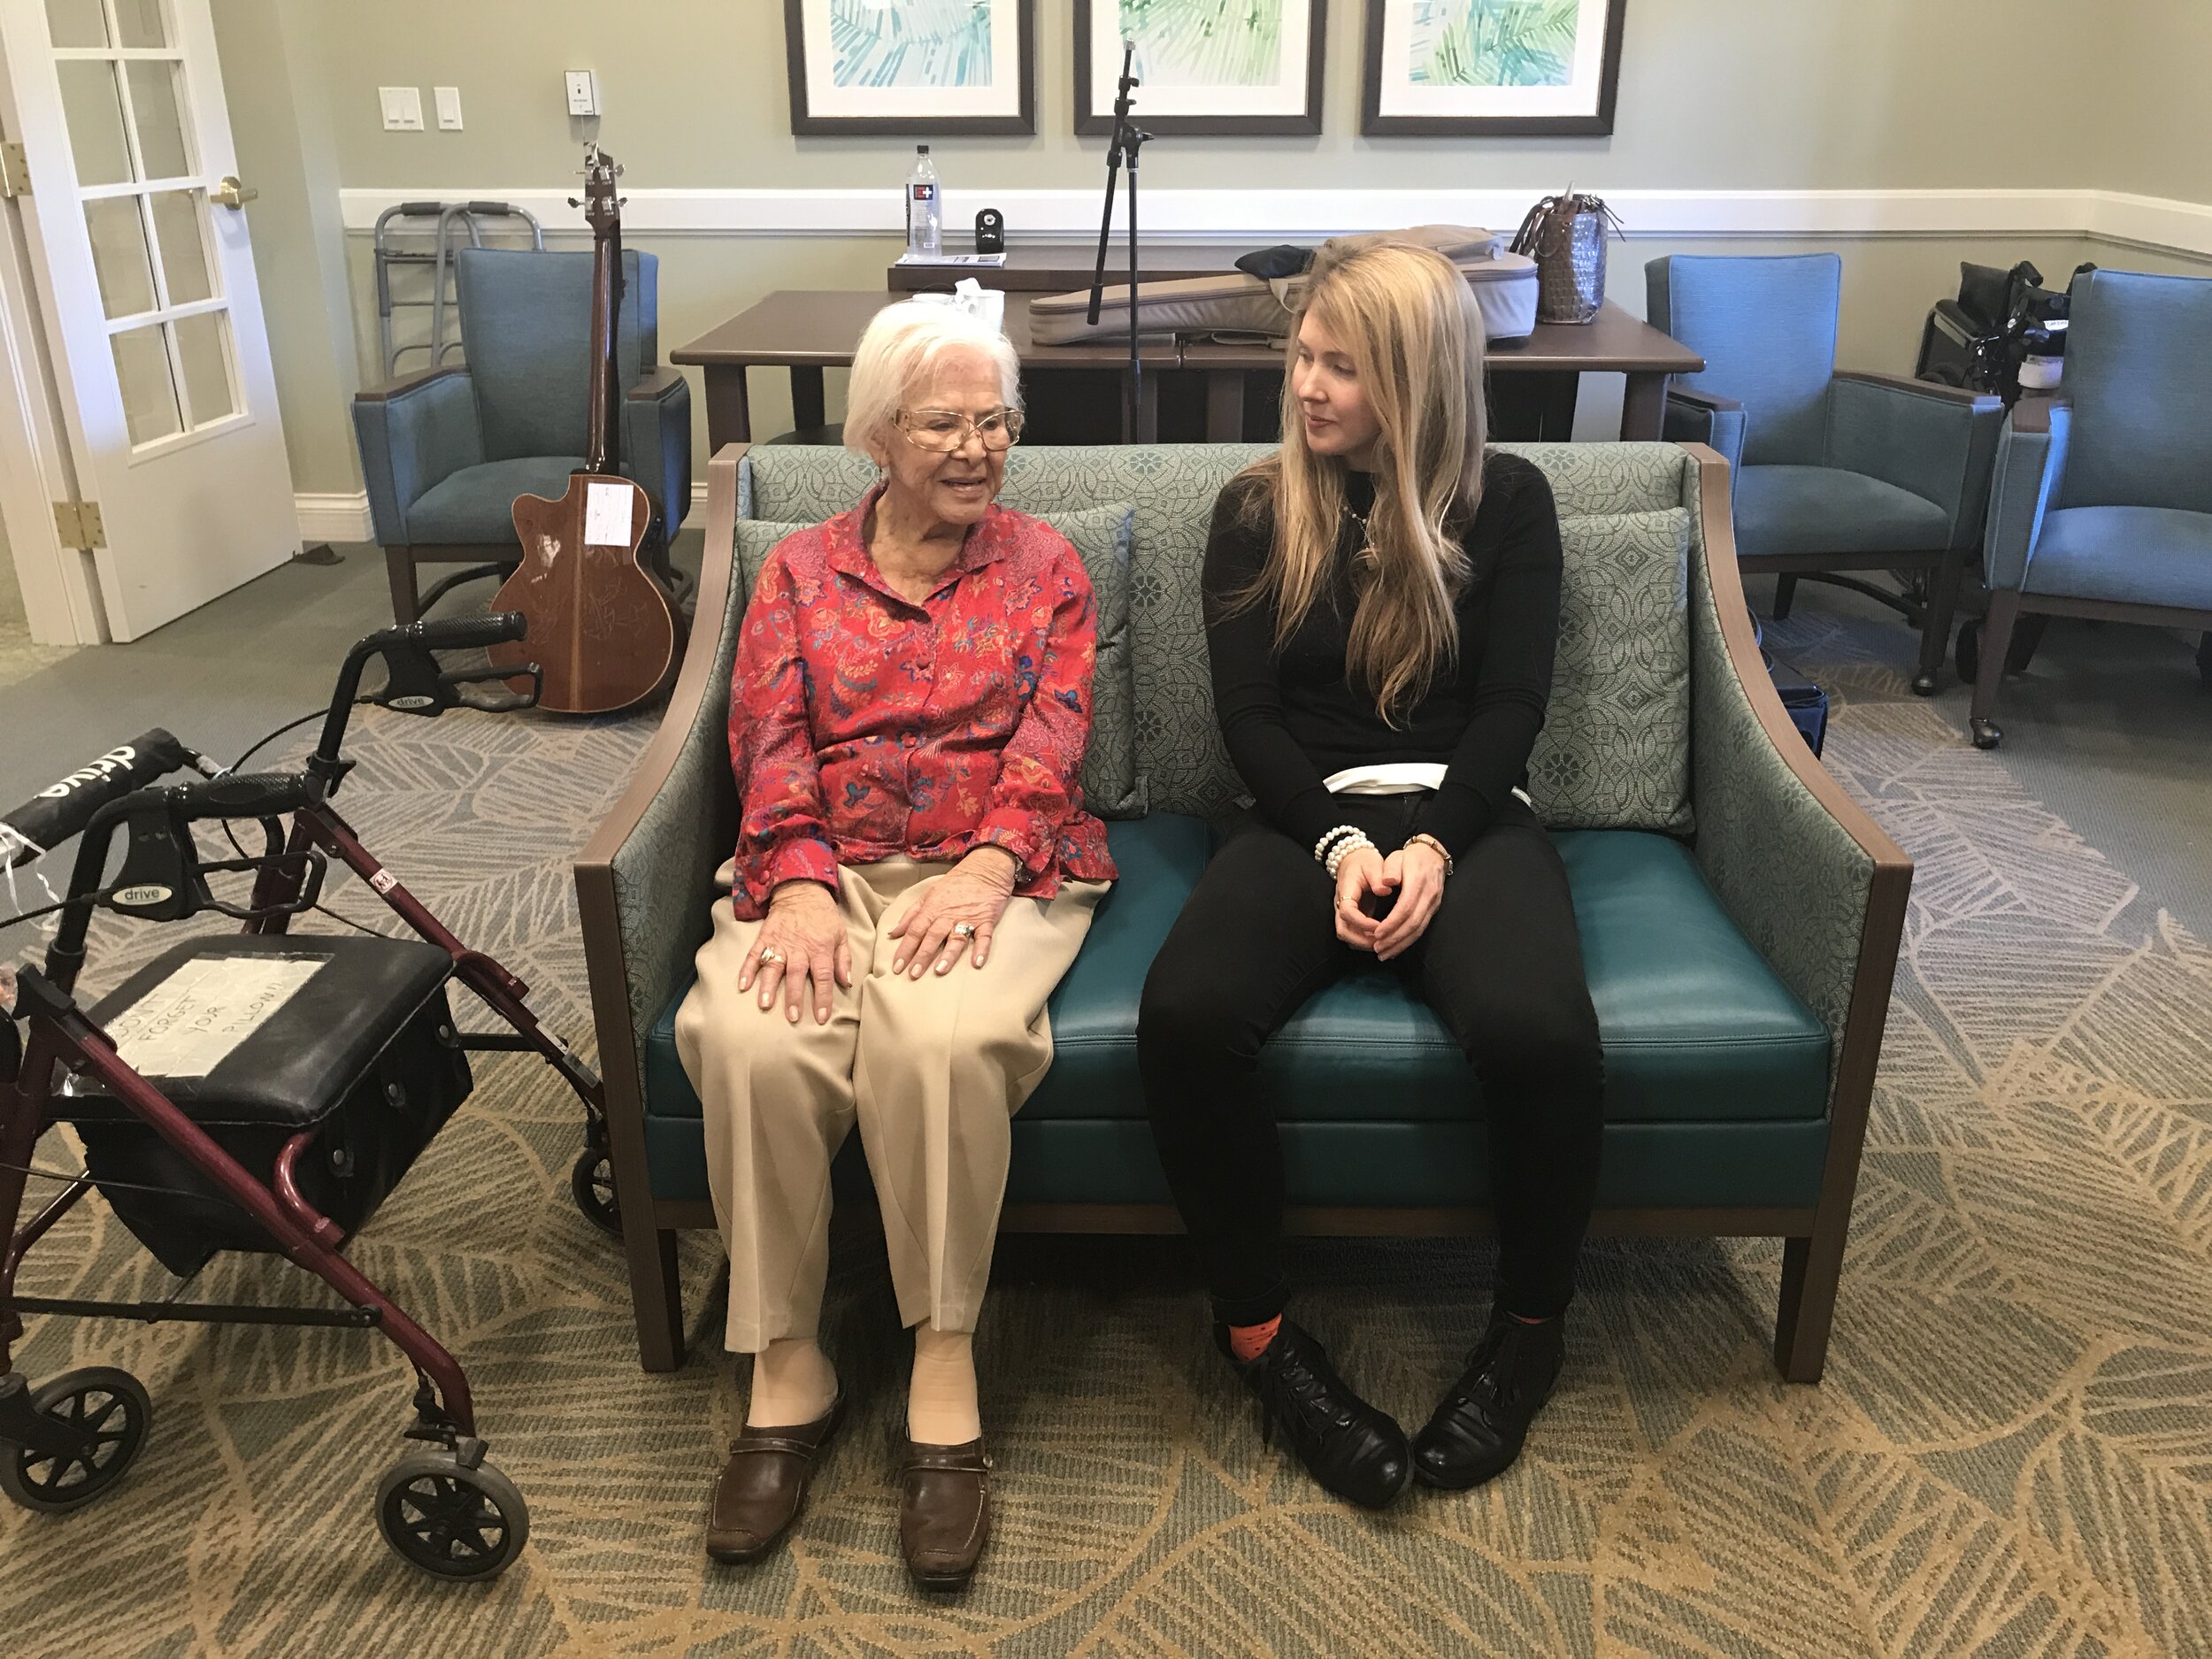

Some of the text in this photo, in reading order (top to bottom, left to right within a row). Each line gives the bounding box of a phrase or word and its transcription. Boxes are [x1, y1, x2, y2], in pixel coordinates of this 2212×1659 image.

[396, 697, 425, 706] drive
[124, 887, 160, 901] drive
[137, 995, 196, 1041] FORGET
[181, 1005, 227, 1036] YOUR
